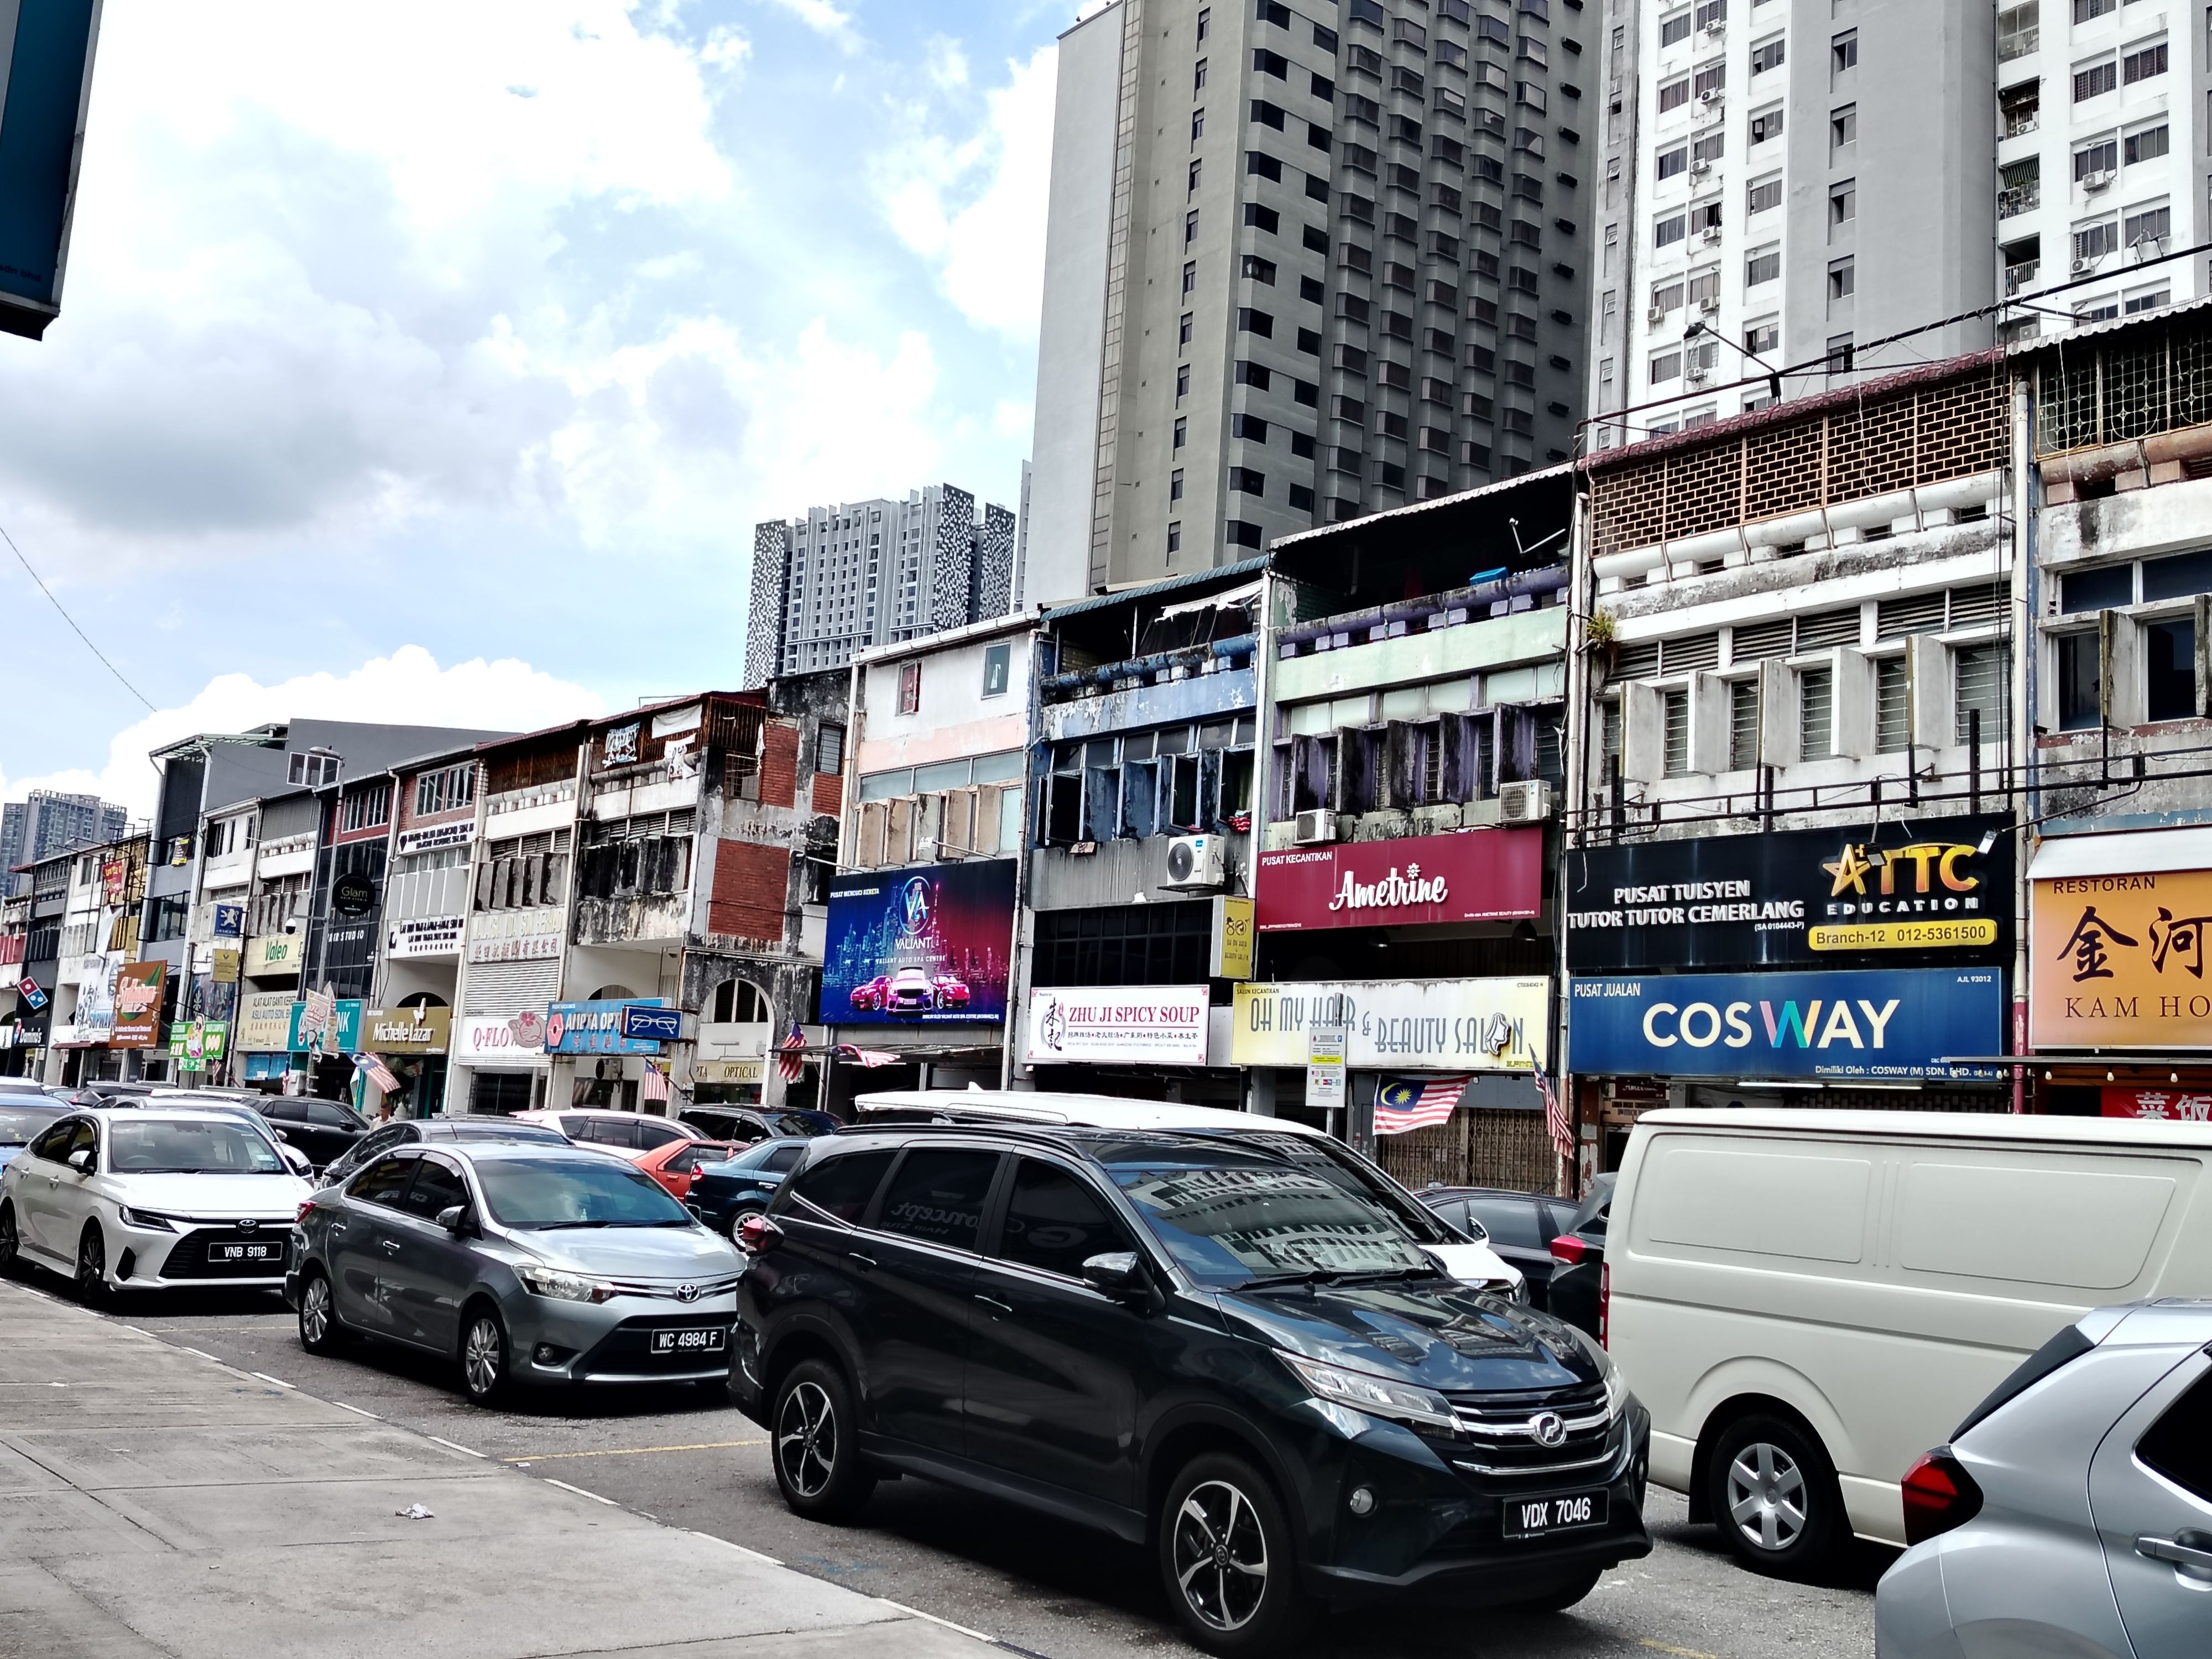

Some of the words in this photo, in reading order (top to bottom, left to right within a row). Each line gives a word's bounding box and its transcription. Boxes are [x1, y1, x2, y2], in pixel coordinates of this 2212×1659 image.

[21, 269, 41, 282] bhd
[1262, 855, 1285, 865] PUSAT
[1286, 851, 1333, 864] KECANTIKAN
[341, 886, 367, 898] Glam
[1329, 864, 1448, 910] Ametrine
[1614, 885, 1670, 904] PUSAT
[1672, 880, 1750, 901] TUISYEN
[2054, 877, 2156, 894] RESTORAN
[1568, 911, 1623, 928] TUTOR
[1626, 907, 1684, 927] TUTOR
[1688, 901, 1804, 923] CEMERLANG
[1827, 898, 1979, 915] EDUCATION
[1755, 923, 1767, 932] (SA
[1817, 930, 1885, 944] Branch-12
[1897, 926, 1986, 941] 012-5361500
[328, 932, 339, 942] AIR
[895, 937, 933, 950] VALIANT
[265, 941, 288, 961] Valeo
[1575, 984, 1603, 997] PUSAT
[1604, 983, 1641, 997] JUALAN
[1069, 1006, 1097, 1022] ZHU
[1099, 1006, 1113, 1022] JI
[1115, 1006, 1157, 1022] SPICY
[1160, 1006, 1199, 1022] SOUP
[2065, 997, 2138, 1018] KAM
[2159, 996, 2211, 1018] HO
[600, 1013, 620, 1030] OPT
[1251, 998, 1272, 1032] OH
[1280, 997, 1304, 1031] MY
[1363, 1011, 1371, 1036] &
[1375, 1018, 1446, 1053] BEAUTY
[1643, 1000, 1901, 1048] COSWAY
[373, 1021, 409, 1041] Michelle
[409, 1023, 434, 1041] Lazar
[724, 1066, 758, 1078] OPTICAL
[1815, 1066, 1843, 1074] Dimiliki
[1846, 1066, 1864, 1074] Oleh
[1871, 1066, 1908, 1074] COSWAY
[1910, 1066, 1923, 1076] (M)
[1926, 1067, 1947, 1075] SDN.
[225, 1246, 243, 1257] VNB
[247, 1246, 267, 1257] 9118
[660, 1333, 674, 1348] WC
[678, 1332, 707, 1347] 4984
[710, 1332, 717, 1345] F
[1522, 1502, 1548, 1528] VDX
[1556, 1497, 1591, 1524] 7046
